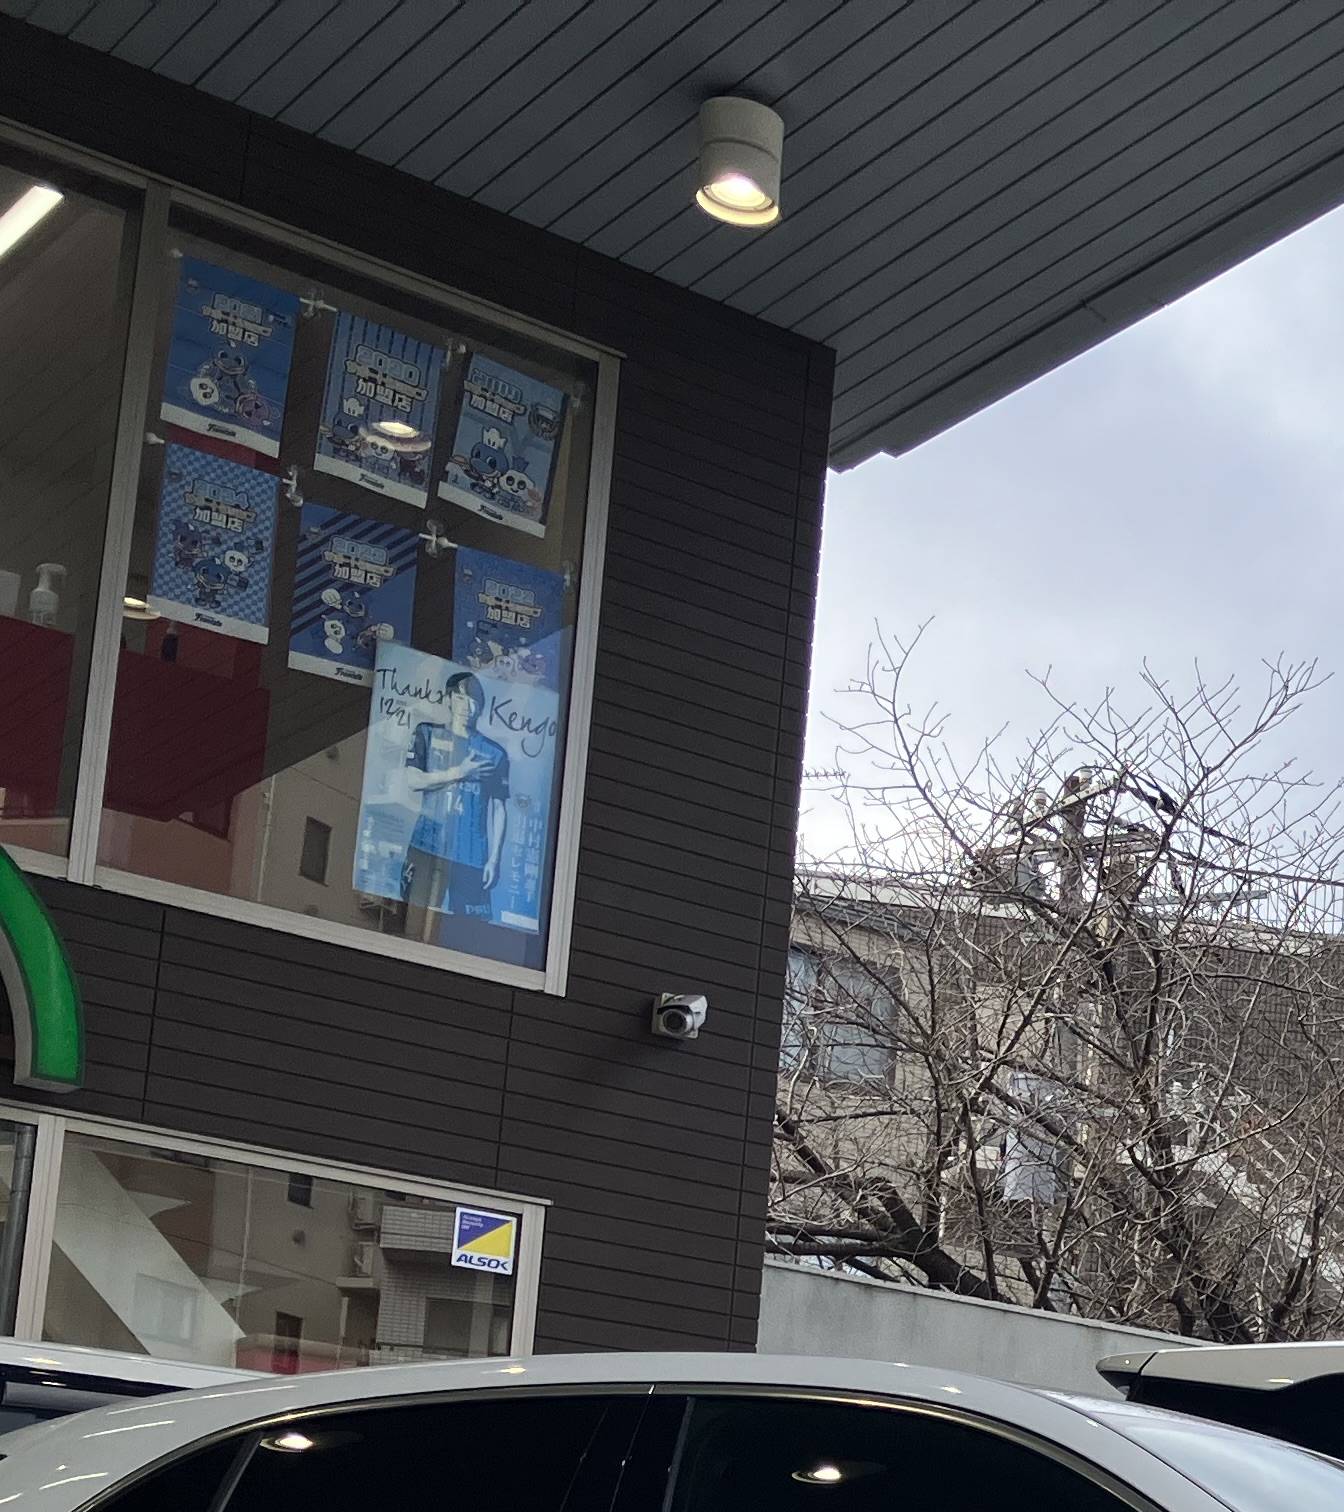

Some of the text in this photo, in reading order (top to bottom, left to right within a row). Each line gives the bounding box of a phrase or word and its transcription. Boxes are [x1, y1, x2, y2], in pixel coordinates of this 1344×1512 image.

[356, 379, 413, 413] 加盟店
[456, 1253, 509, 1271] ALSOK
